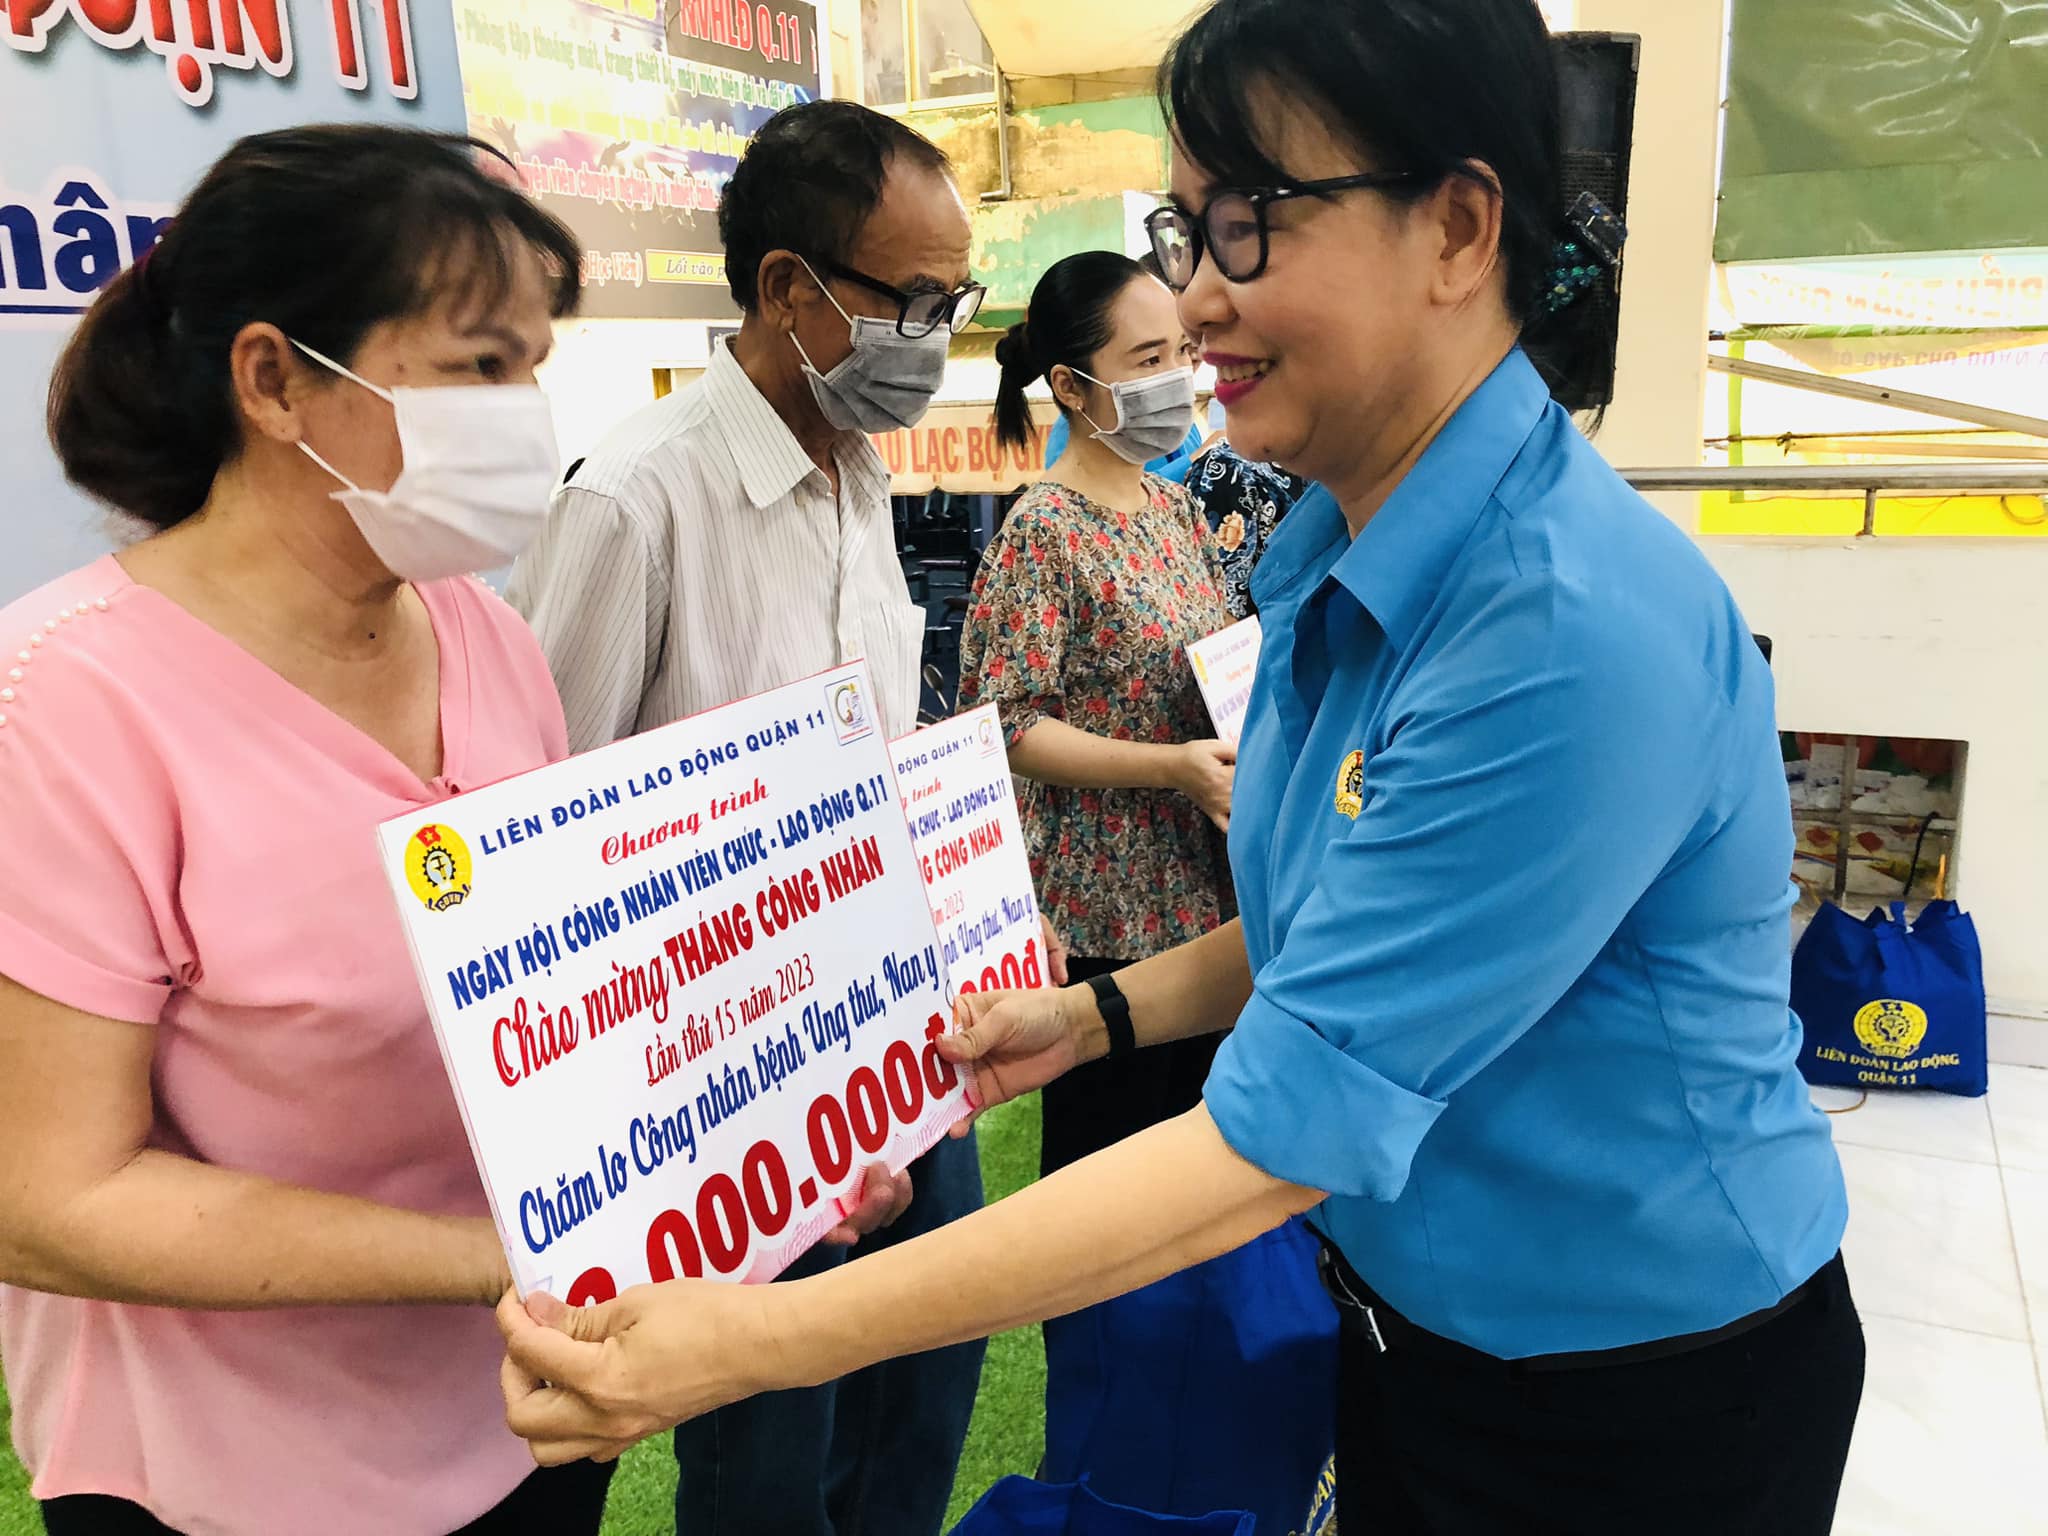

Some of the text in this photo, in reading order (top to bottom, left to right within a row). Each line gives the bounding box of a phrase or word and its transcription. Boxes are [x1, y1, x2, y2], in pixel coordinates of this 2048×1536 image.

[756, 4, 801, 63] Q.11
[667, 256, 688, 274] Lối
[691, 263, 713, 276] vào
[910, 427, 959, 482] LẠC
[967, 412, 1003, 481] BỘ
[480, 709, 825, 855] LIÊN ĐOÀN LAO ĐỘNG QUẬN 11
[897, 735, 974, 775] ĐỘNG QUẬN 11
[600, 777, 770, 866] Chương trình
[946, 798, 963, 823] LAO
[964, 786, 988, 816] ĐỘNG
[988, 777, 1007, 803] Q.11
[934, 836, 968, 878] CÔNG
[968, 818, 1003, 860] NHÂN
[447, 944, 515, 1011] NGÀY
[515, 922, 562, 977] HỘI
[562, 896, 621, 954] CÔNG
[620, 869, 680, 926] NHÂN
[676, 848, 723, 896] VIÊN
[777, 809, 810, 849] LAO
[809, 788, 855, 836] ĐỘNG
[855, 773, 889, 813] Q.11
[1001, 895, 1026, 928] Nan
[492, 995, 579, 1088] Chào
[581, 955, 670, 1025] mừng
[663, 902, 755, 988] THÁNG
[755, 867, 821, 938] CÔNG
[820, 835, 885, 903] NHÂN
[645, 953, 815, 1087] Lần thứ 15 năm 2023
[1816, 1046, 1960, 1072] LIÊN ĐOÀN LAO ĐỘNG
[1857, 1070, 1917, 1086] QUẬN 11
[519, 1170, 603, 1254] Chăm
[629, 1103, 698, 1177] Công
[695, 1062, 757, 1134] nhân
[752, 1021, 806, 1093] bệnh
[847, 974, 886, 1028] thư,
[882, 951, 926, 1003] Nan
[923, 944, 939, 992] y
